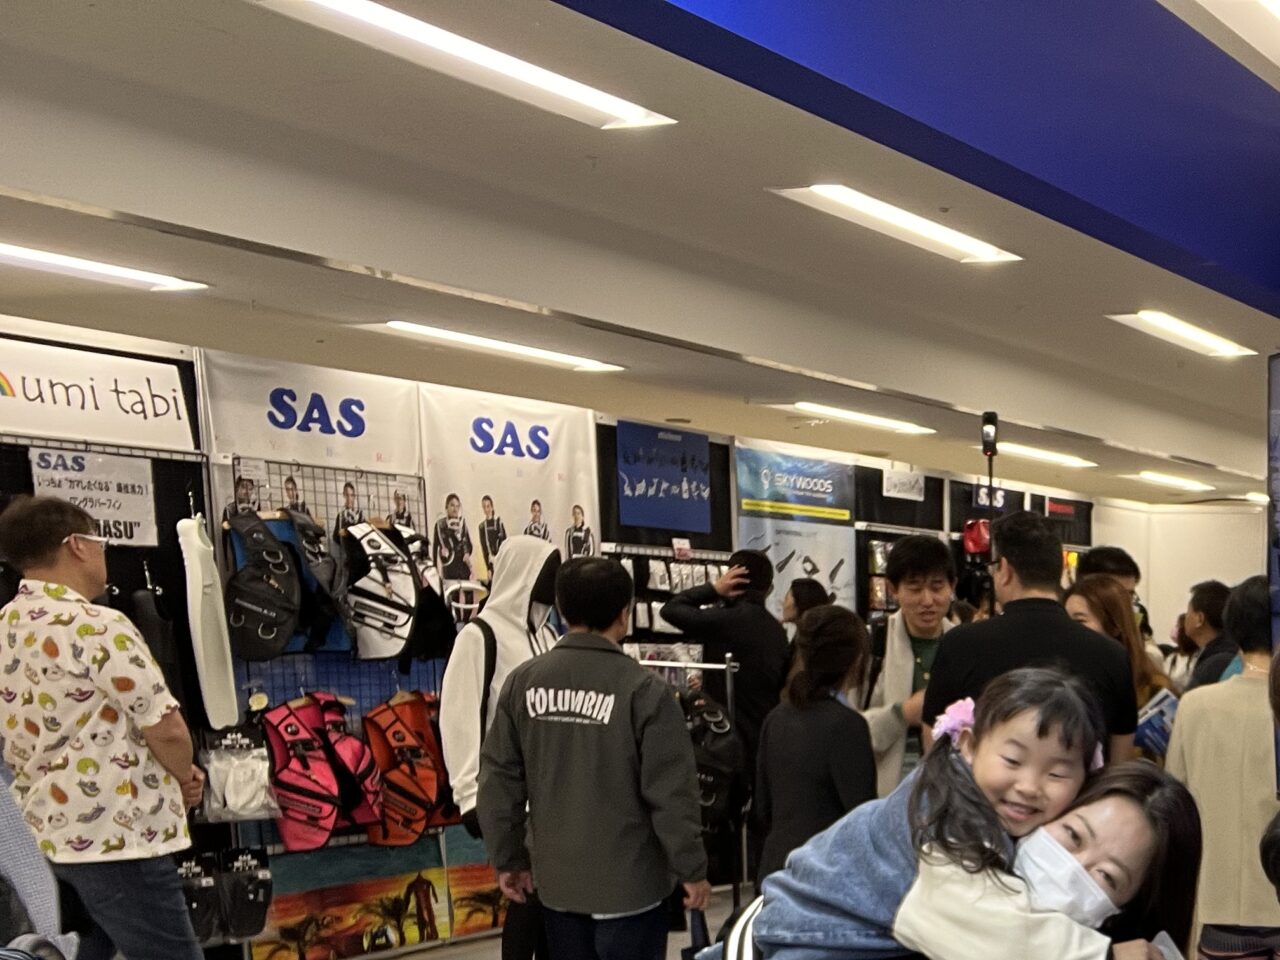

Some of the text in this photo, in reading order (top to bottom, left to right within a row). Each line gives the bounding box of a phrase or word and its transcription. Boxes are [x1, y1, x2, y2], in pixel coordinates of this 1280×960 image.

[21, 375, 182, 421] umi tabi
[266, 387, 366, 438] SAS
[469, 416, 551, 460] SAS
[36, 452, 86, 472] SAS
[774, 473, 834, 493] SKYWOODS
[977, 487, 1006, 508] SS
